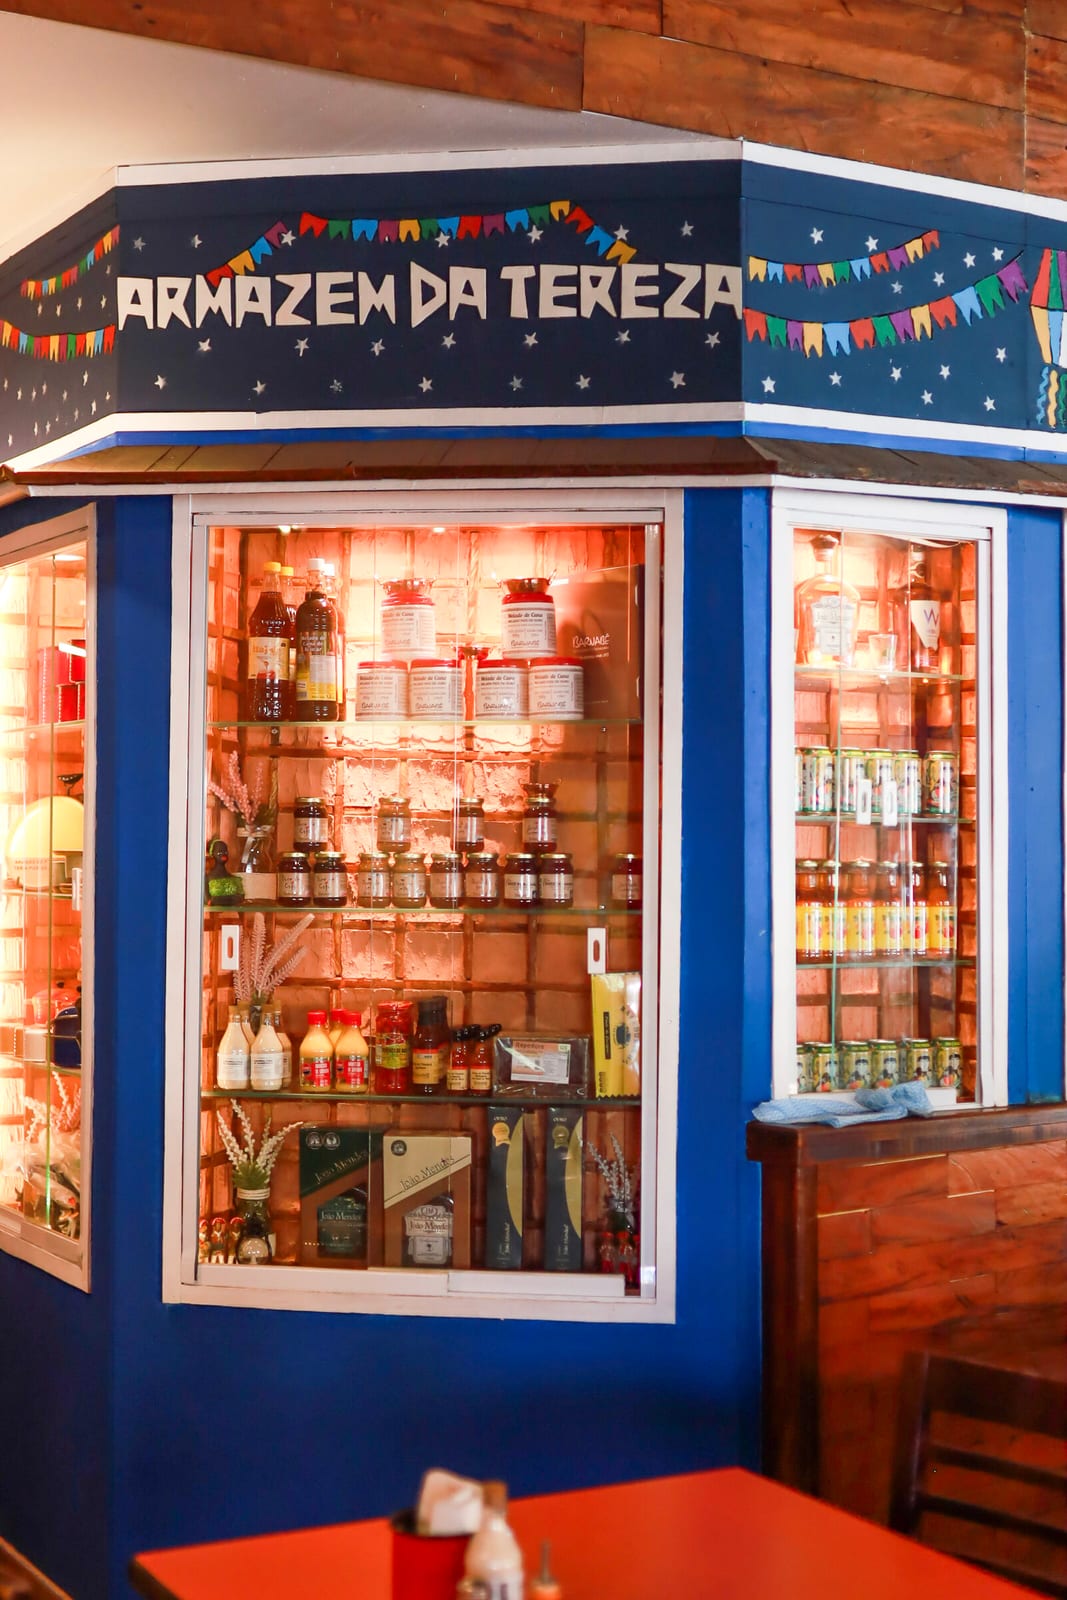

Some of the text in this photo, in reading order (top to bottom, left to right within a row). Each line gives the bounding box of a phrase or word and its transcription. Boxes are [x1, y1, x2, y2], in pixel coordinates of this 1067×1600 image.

[116, 261, 743, 331] ARMAZEM DA TEREZA
